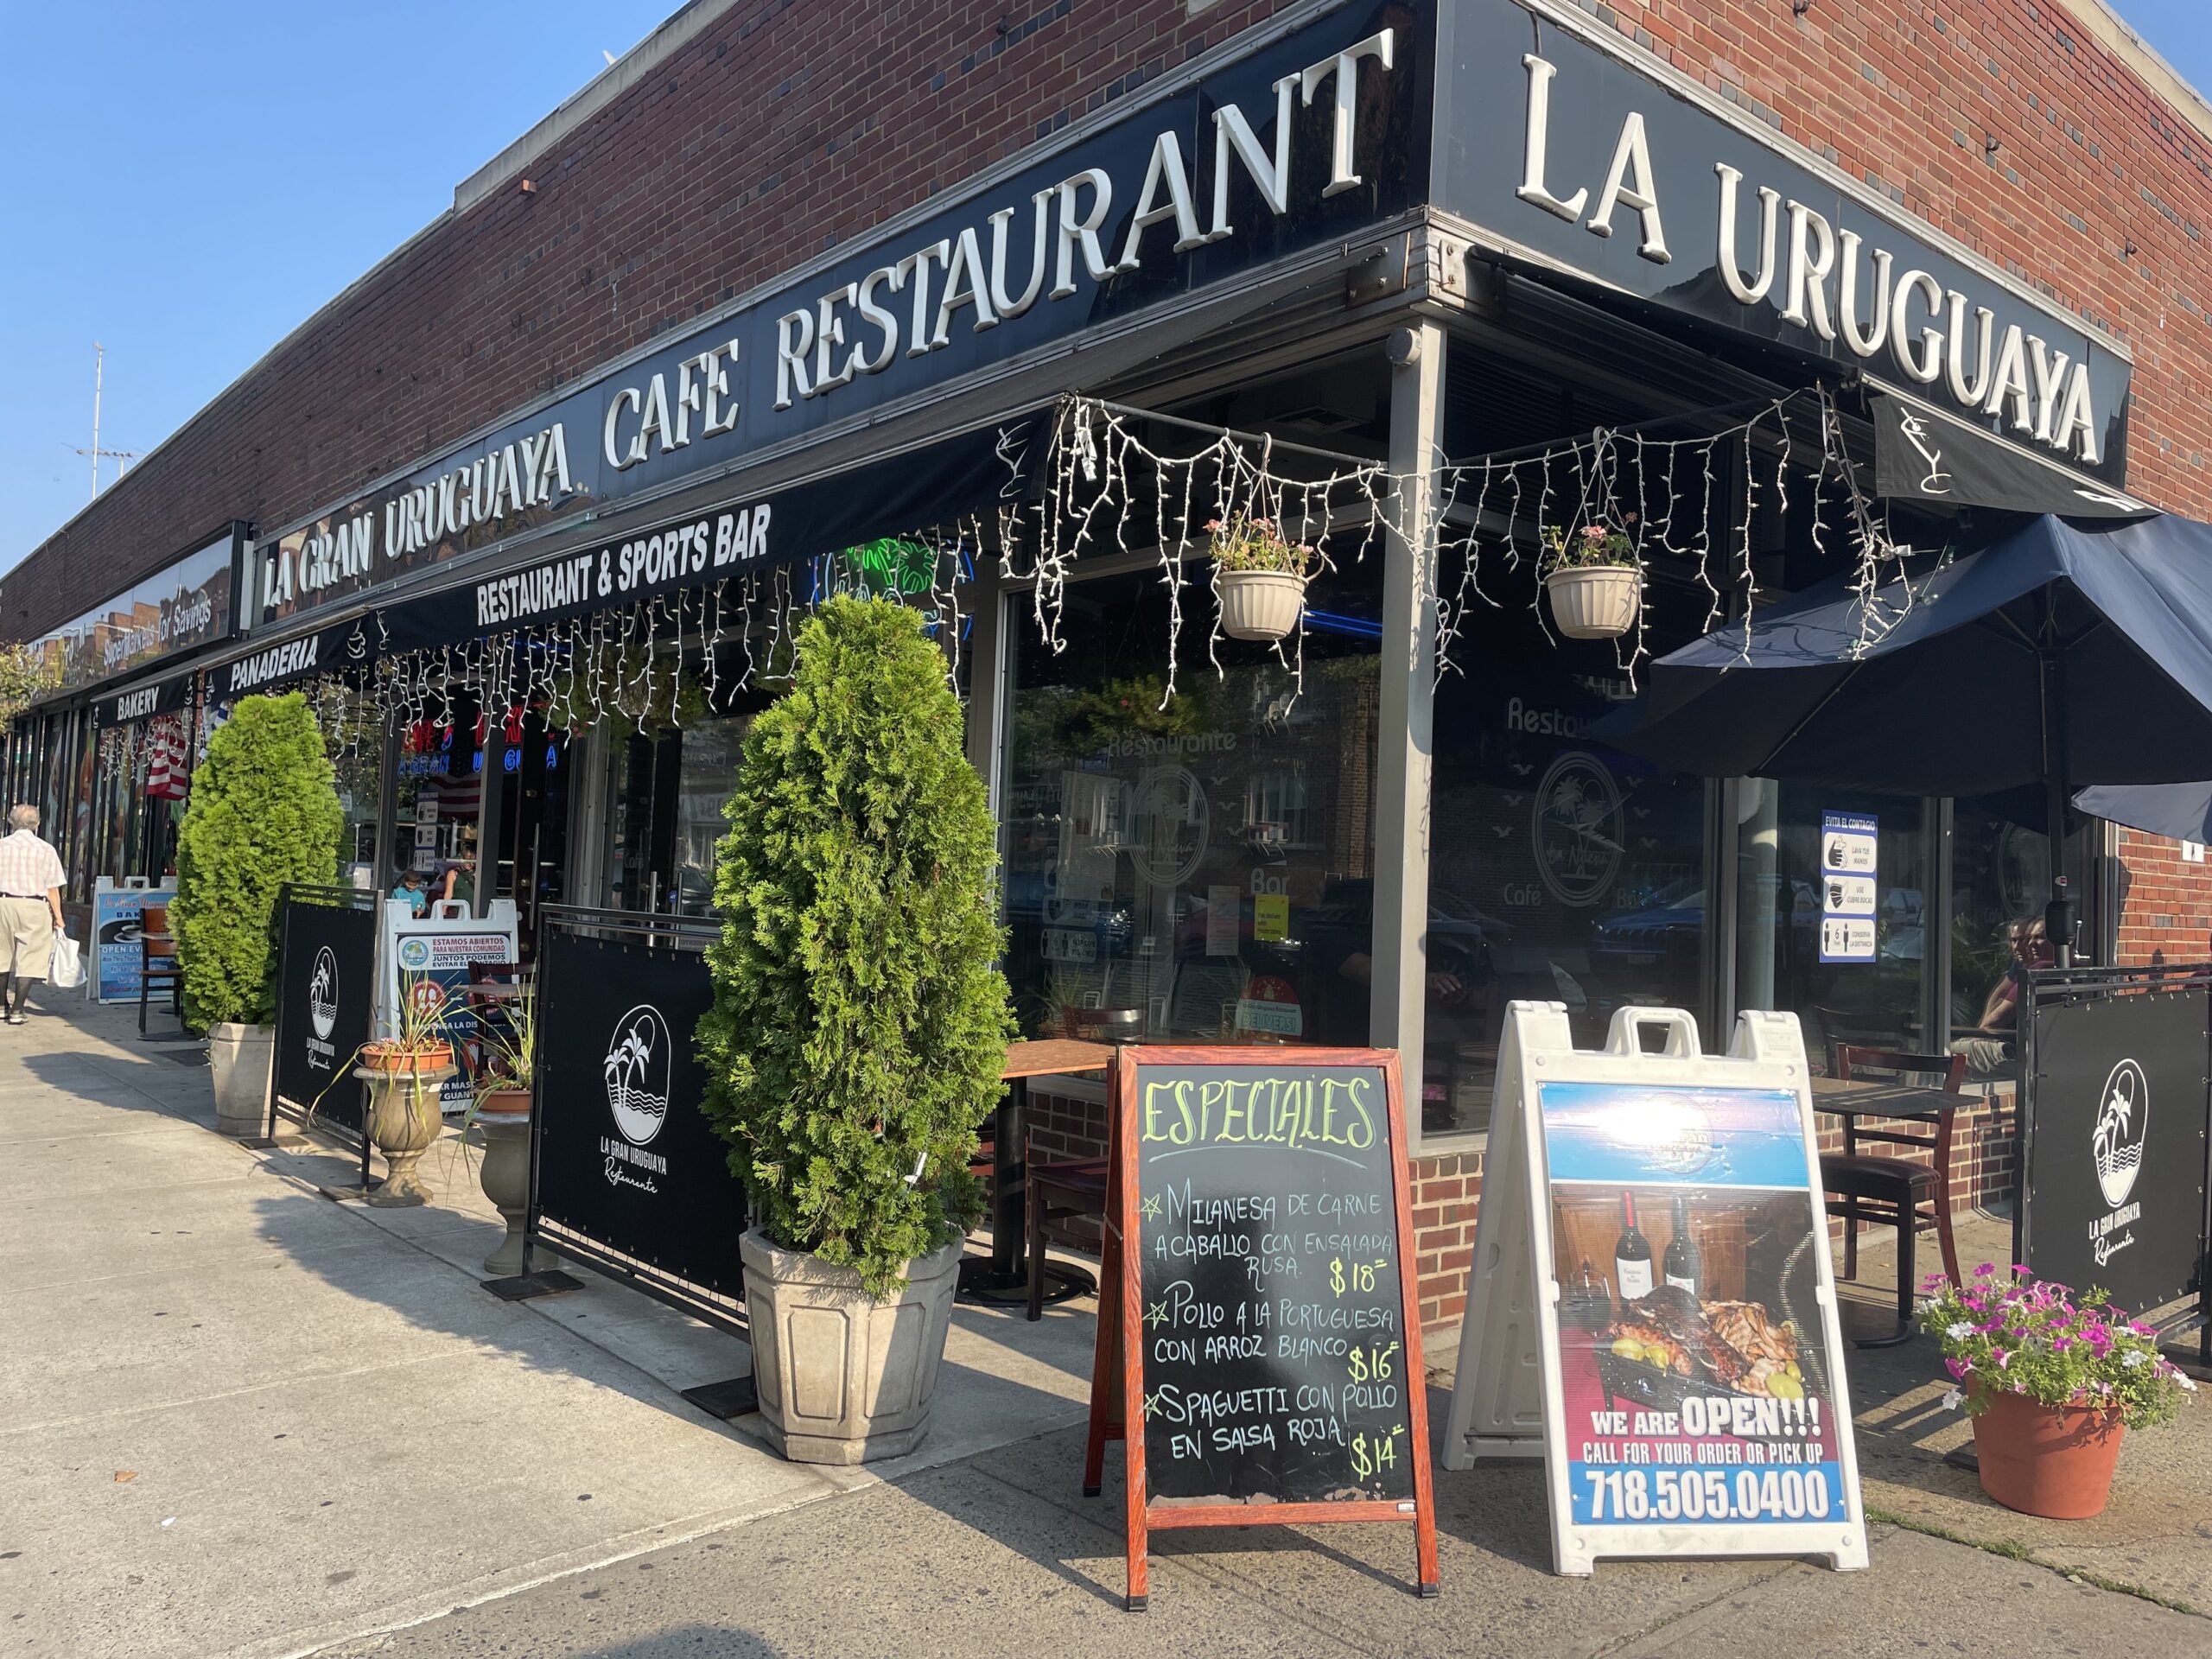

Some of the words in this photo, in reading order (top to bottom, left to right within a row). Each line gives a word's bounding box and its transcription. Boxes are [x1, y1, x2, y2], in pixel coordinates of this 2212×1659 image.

[1516, 52, 1672, 265] LA
[1713, 162, 2101, 467] URUGUAYA
[264, 551, 292, 607] LA
[299, 512, 374, 594] GRAN
[385, 423, 573, 561] URUGUAYA
[605, 337, 739, 472] CAFE
[772, 28, 1394, 412] RESTAURANT
[477, 556, 592, 626] RESTAURANT
[597, 550, 612, 595] &
[618, 520, 708, 591] SPORTS
[713, 503, 772, 567] BAR
[158, 610, 171, 642] for
[173, 599, 212, 637] Savings
[230, 635, 318, 692] PANADERIA
[118, 686, 159, 721] BAKERY
[1508, 696, 1591, 741] Restau
[1110, 730, 1237, 758] Restaurante
[1825, 816, 1840, 828] EVITA
[1841, 817, 1848, 828] EL
[1848, 818, 1876, 831] CONTAGIO
[1251, 868, 1289, 895] Bar
[1504, 883, 1541, 906] Café
[102, 945, 126, 954] OPEN
[1835, 928, 1840, 940] 6
[1243, 1012, 1296, 1033] DELIVERS!
[1142, 1077, 1376, 1151] ESPECIALES
[601, 1135, 609, 1154] LA
[611, 1140, 629, 1162] GRAN
[630, 1146, 667, 1175] URUGUAYA
[1167, 1178, 1276, 1233] MILANESA
[1288, 1193, 1311, 1216] DE
[1317, 1193, 1382, 1226] CARNE
[1261, 1234, 1297, 1255] CON
[1305, 1233, 1392, 1260] ENSALADA
[2088, 1219, 2099, 1240] LA
[1164, 1281, 1224, 1328] POLLO
[1236, 1301, 1246, 1334] A
[1255, 1301, 1272, 1329] LA
[1280, 1299, 1394, 1332] PORTUGUESA
[1154, 1338, 1196, 1366] CON
[1205, 1335, 1267, 1364] ARROZ
[1278, 1335, 1348, 1367] BLANCO
[1159, 1383, 1290, 1427] SPAGUETTI
[1296, 1384, 1335, 1412] CON
[1343, 1383, 1398, 1423] POLLO
[1590, 1411, 1628, 1436] WE
[1634, 1411, 1681, 1436] ARE
[1681, 1396, 1822, 1437] OPEN!!!
[1172, 1429, 1202, 1459] EN
[1212, 1424, 1276, 1455] SALSA
[1287, 1415, 1346, 1447] ROJA
[1583, 1441, 1618, 1465] CALL
[1623, 1442, 1650, 1465] FOR
[1655, 1442, 1692, 1465] YOUR
[1697, 1442, 1742, 1465] ORDER
[1746, 1442, 1765, 1465] OR
[1768, 1442, 1804, 1465] PICK
[1805, 1443, 1823, 1465] UP
[1585, 1470, 1829, 1519] 718.505.0400
